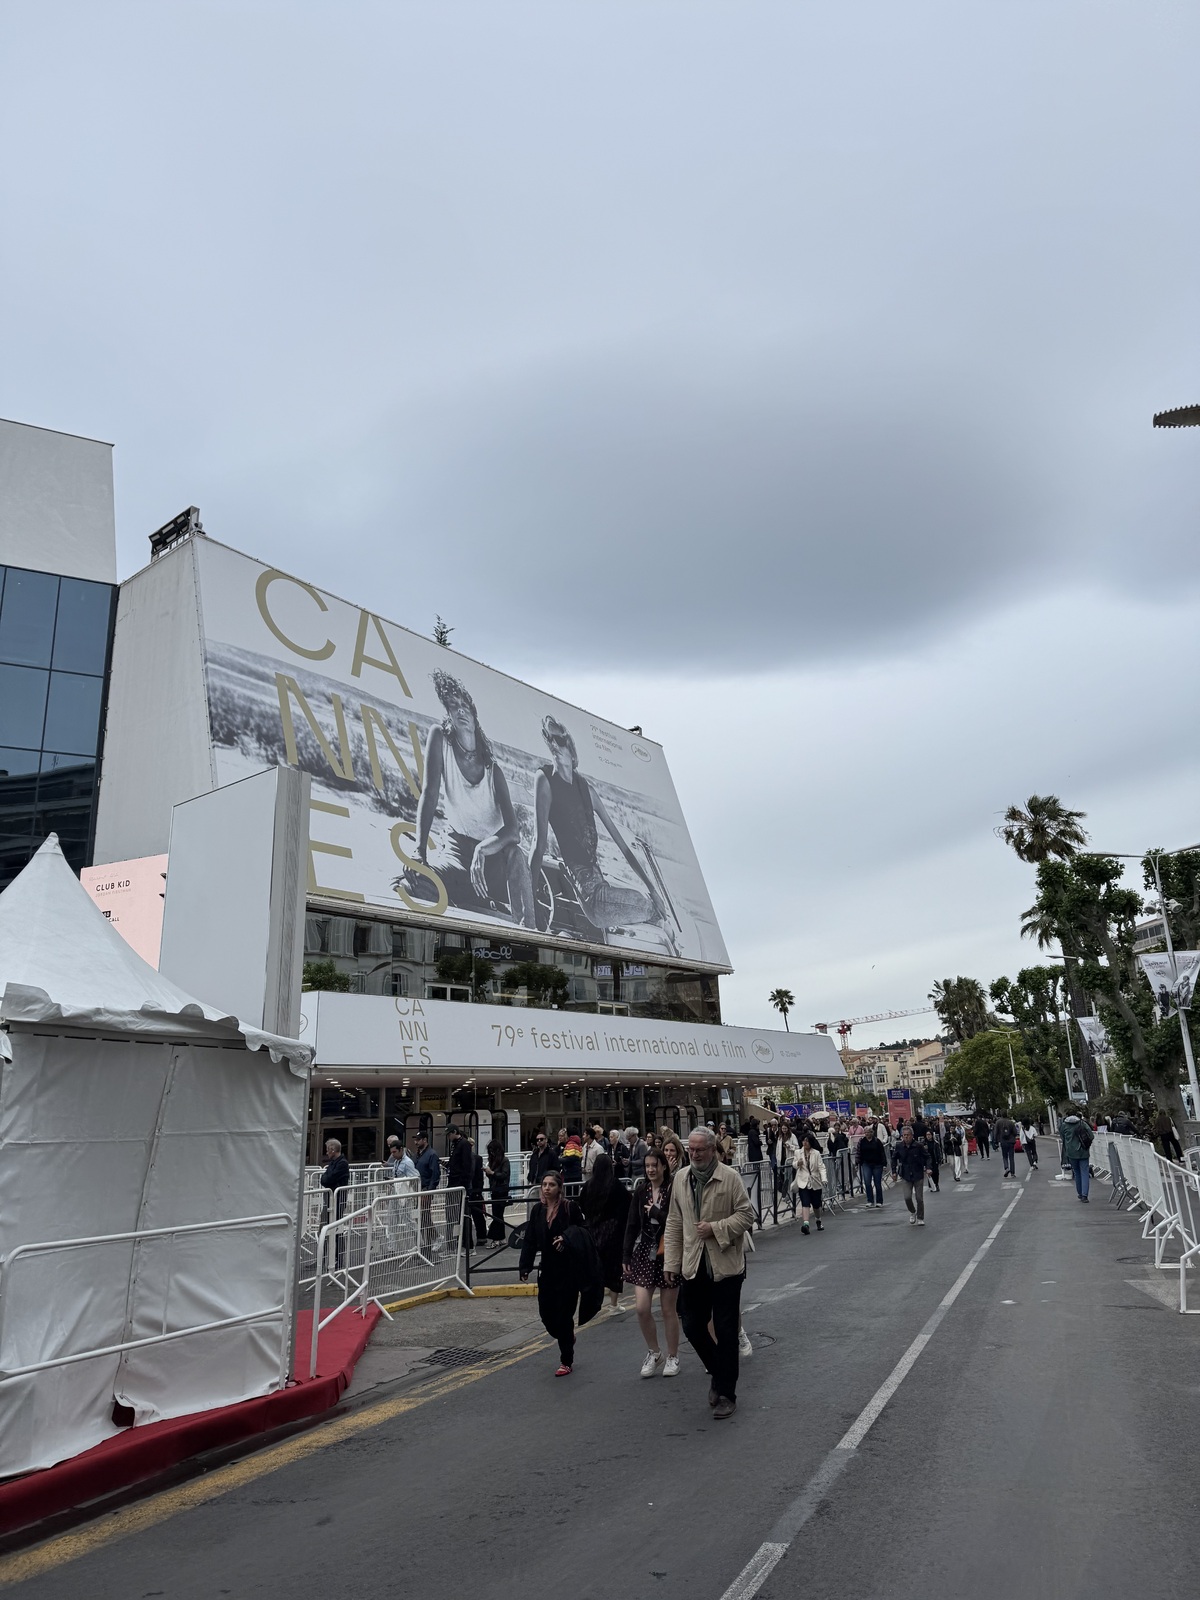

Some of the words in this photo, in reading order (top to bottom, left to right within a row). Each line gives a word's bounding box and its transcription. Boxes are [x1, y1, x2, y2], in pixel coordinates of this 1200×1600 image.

[255, 568, 413, 699] CA
[274, 671, 425, 801] NN
[306, 799, 449, 915] ES
[95, 882, 115, 891] CLUB
[117, 879, 131, 888] KID
[395, 998, 425, 1016] CA
[398, 1020, 429, 1042] NN
[491, 1025, 524, 1047] 79e
[531, 1027, 600, 1051] festival
[603, 1032, 700, 1056] international
[703, 1039, 720, 1057] du
[721, 1040, 747, 1059] film
